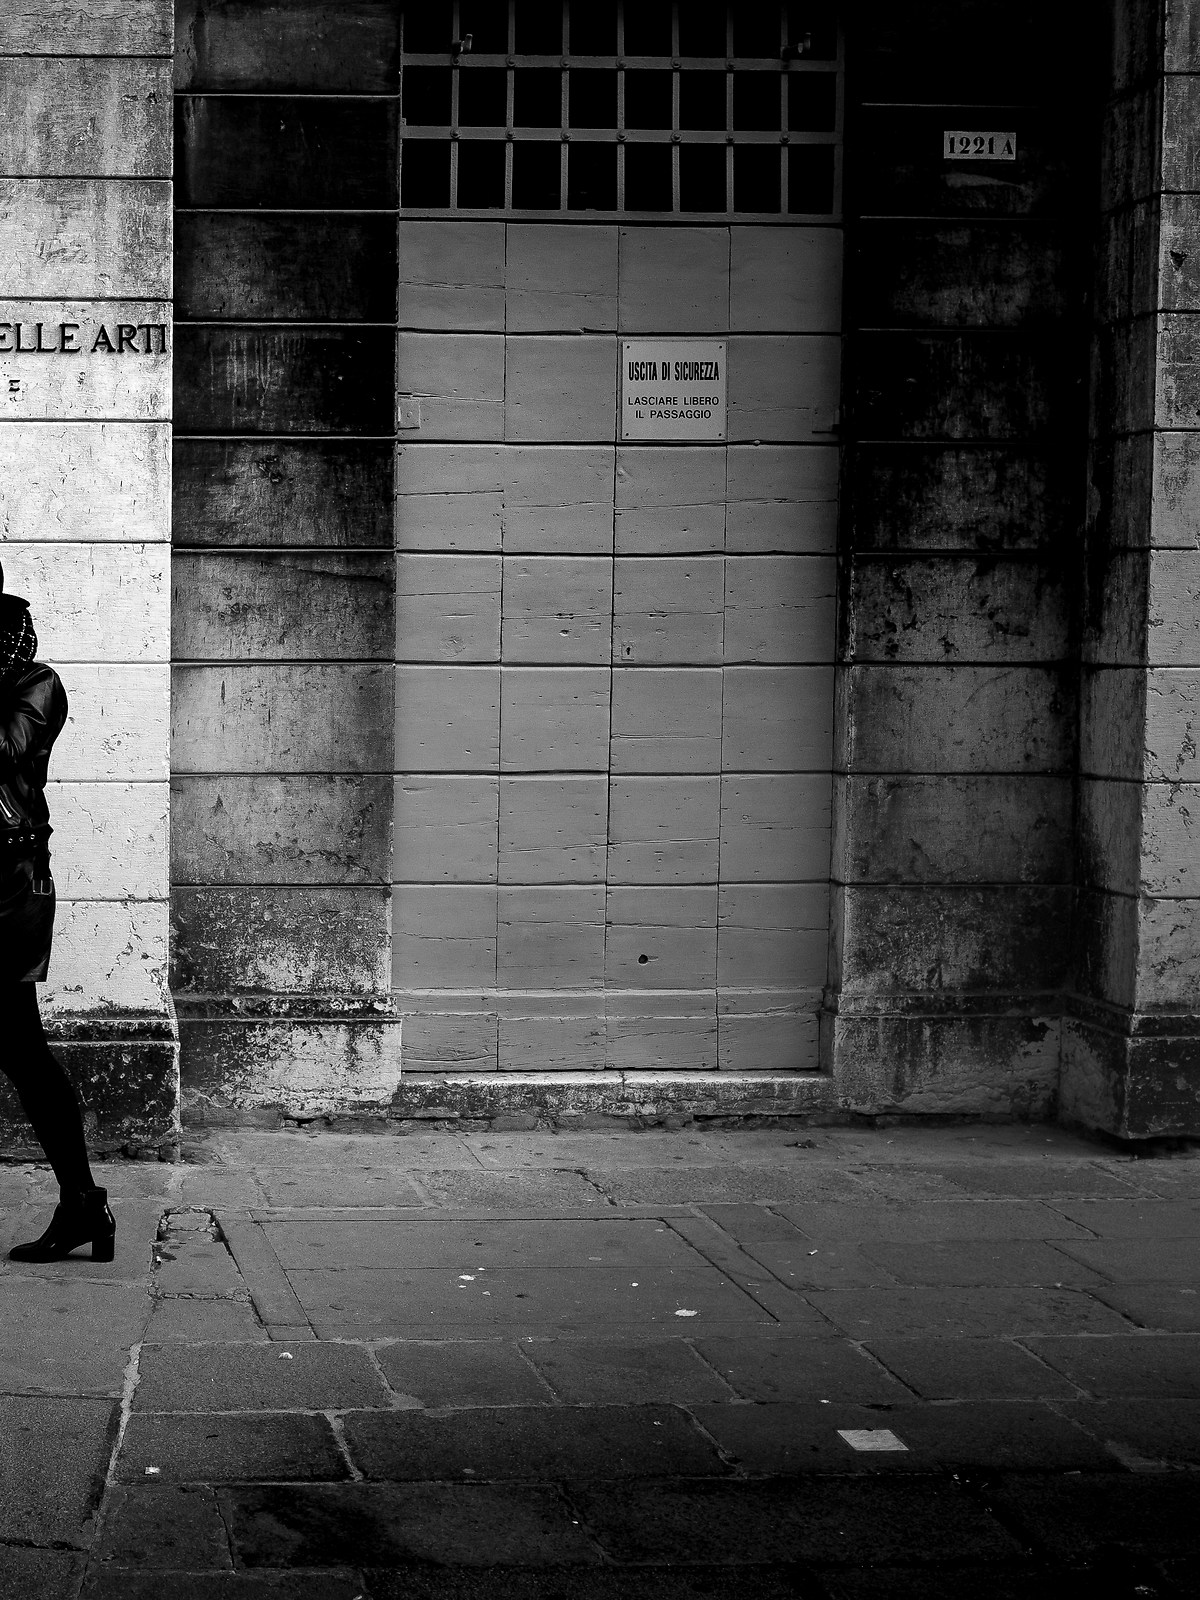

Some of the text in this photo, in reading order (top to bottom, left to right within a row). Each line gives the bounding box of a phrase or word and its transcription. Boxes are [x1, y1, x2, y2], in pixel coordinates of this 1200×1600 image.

[90, 323, 168, 353] ARTI
[628, 361, 720, 381] USCITA DI SICUREZZA
[627, 396, 720, 406] LASCIARE LIBERO
[635, 409, 712, 419] IL PASSAGGIO
